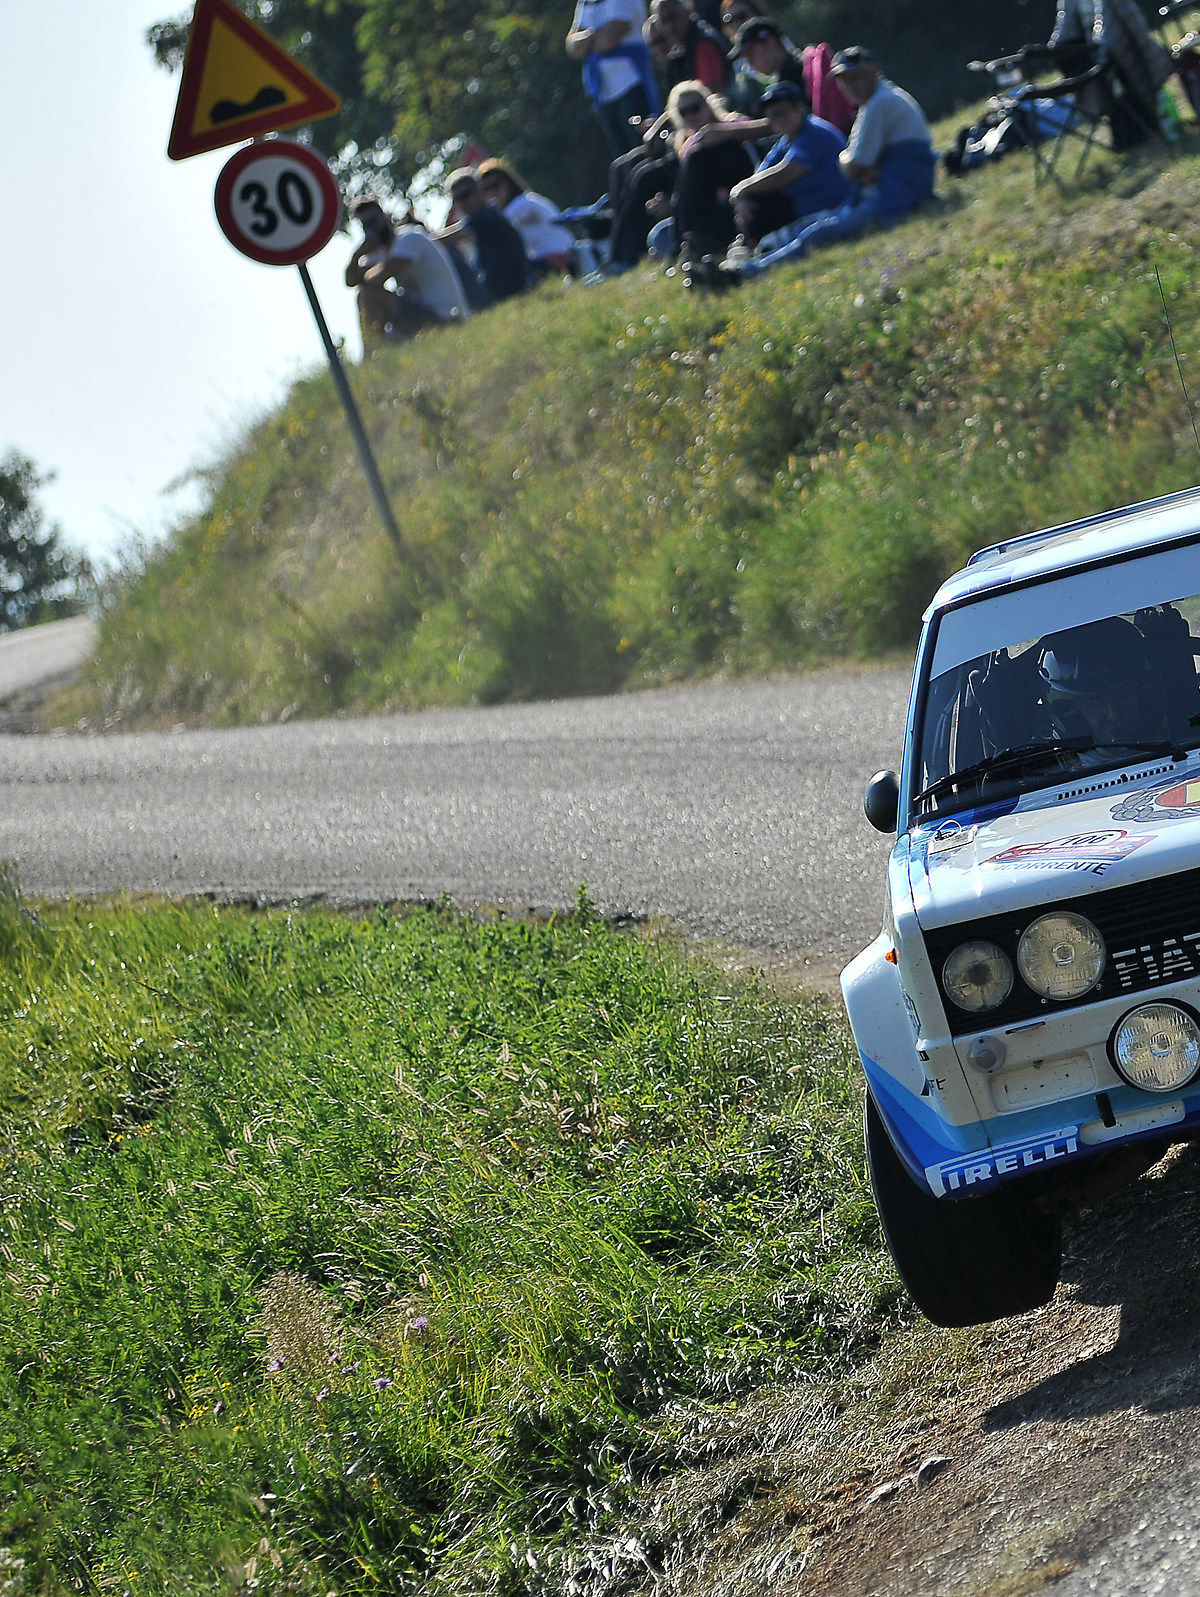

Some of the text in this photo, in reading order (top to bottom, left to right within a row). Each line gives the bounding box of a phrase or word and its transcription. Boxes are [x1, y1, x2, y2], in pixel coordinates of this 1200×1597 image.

[241, 171, 312, 236] 30
[995, 860, 1112, 876] CORRENTE
[925, 1125, 1078, 1198] PIRELLI
